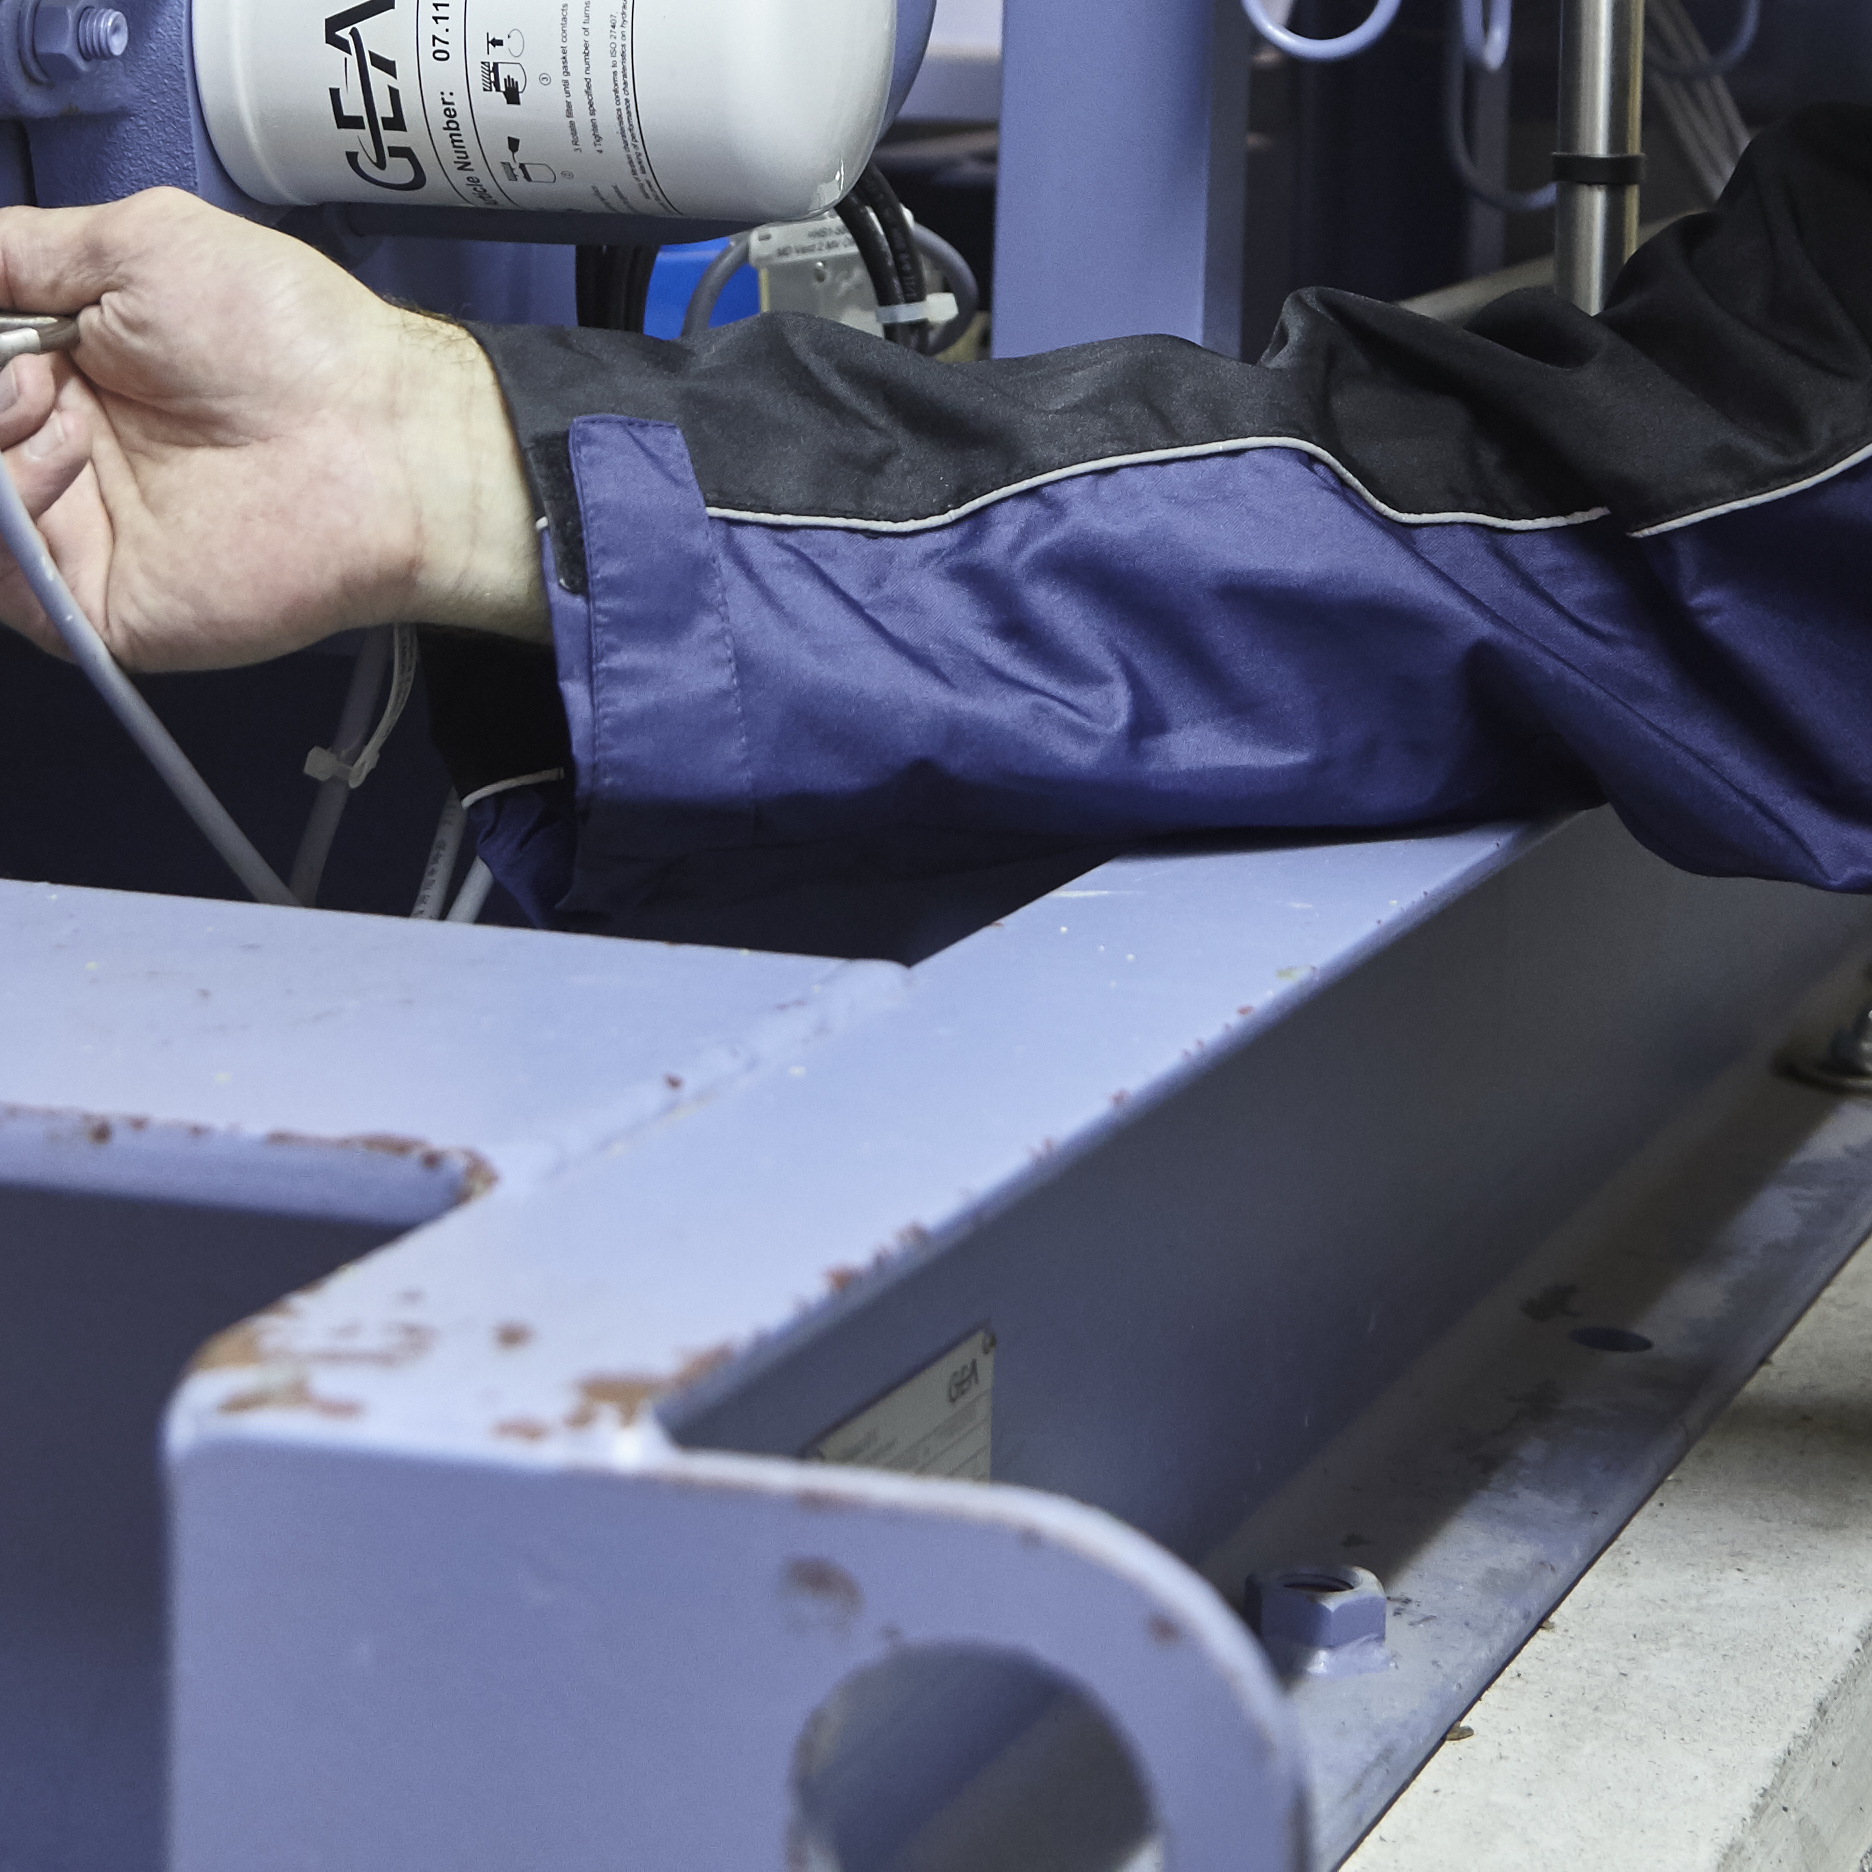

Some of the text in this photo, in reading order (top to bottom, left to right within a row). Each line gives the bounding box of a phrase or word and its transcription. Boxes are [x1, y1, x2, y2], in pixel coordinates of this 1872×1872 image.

[560, 3, 569, 43] contacts
[583, 0, 591, 24] turns
[582, 26, 590, 37] of
[619, 30, 627, 41] on
[560, 45, 571, 77] gasket
[582, 40, 591, 75] number
[609, 41, 617, 58] ISO
[611, 59, 618, 68] to
[562, 79, 571, 98] until
[584, 77, 597, 117] specified
[441, 90, 475, 172] Number:
[590, 118, 602, 147] Tighten
